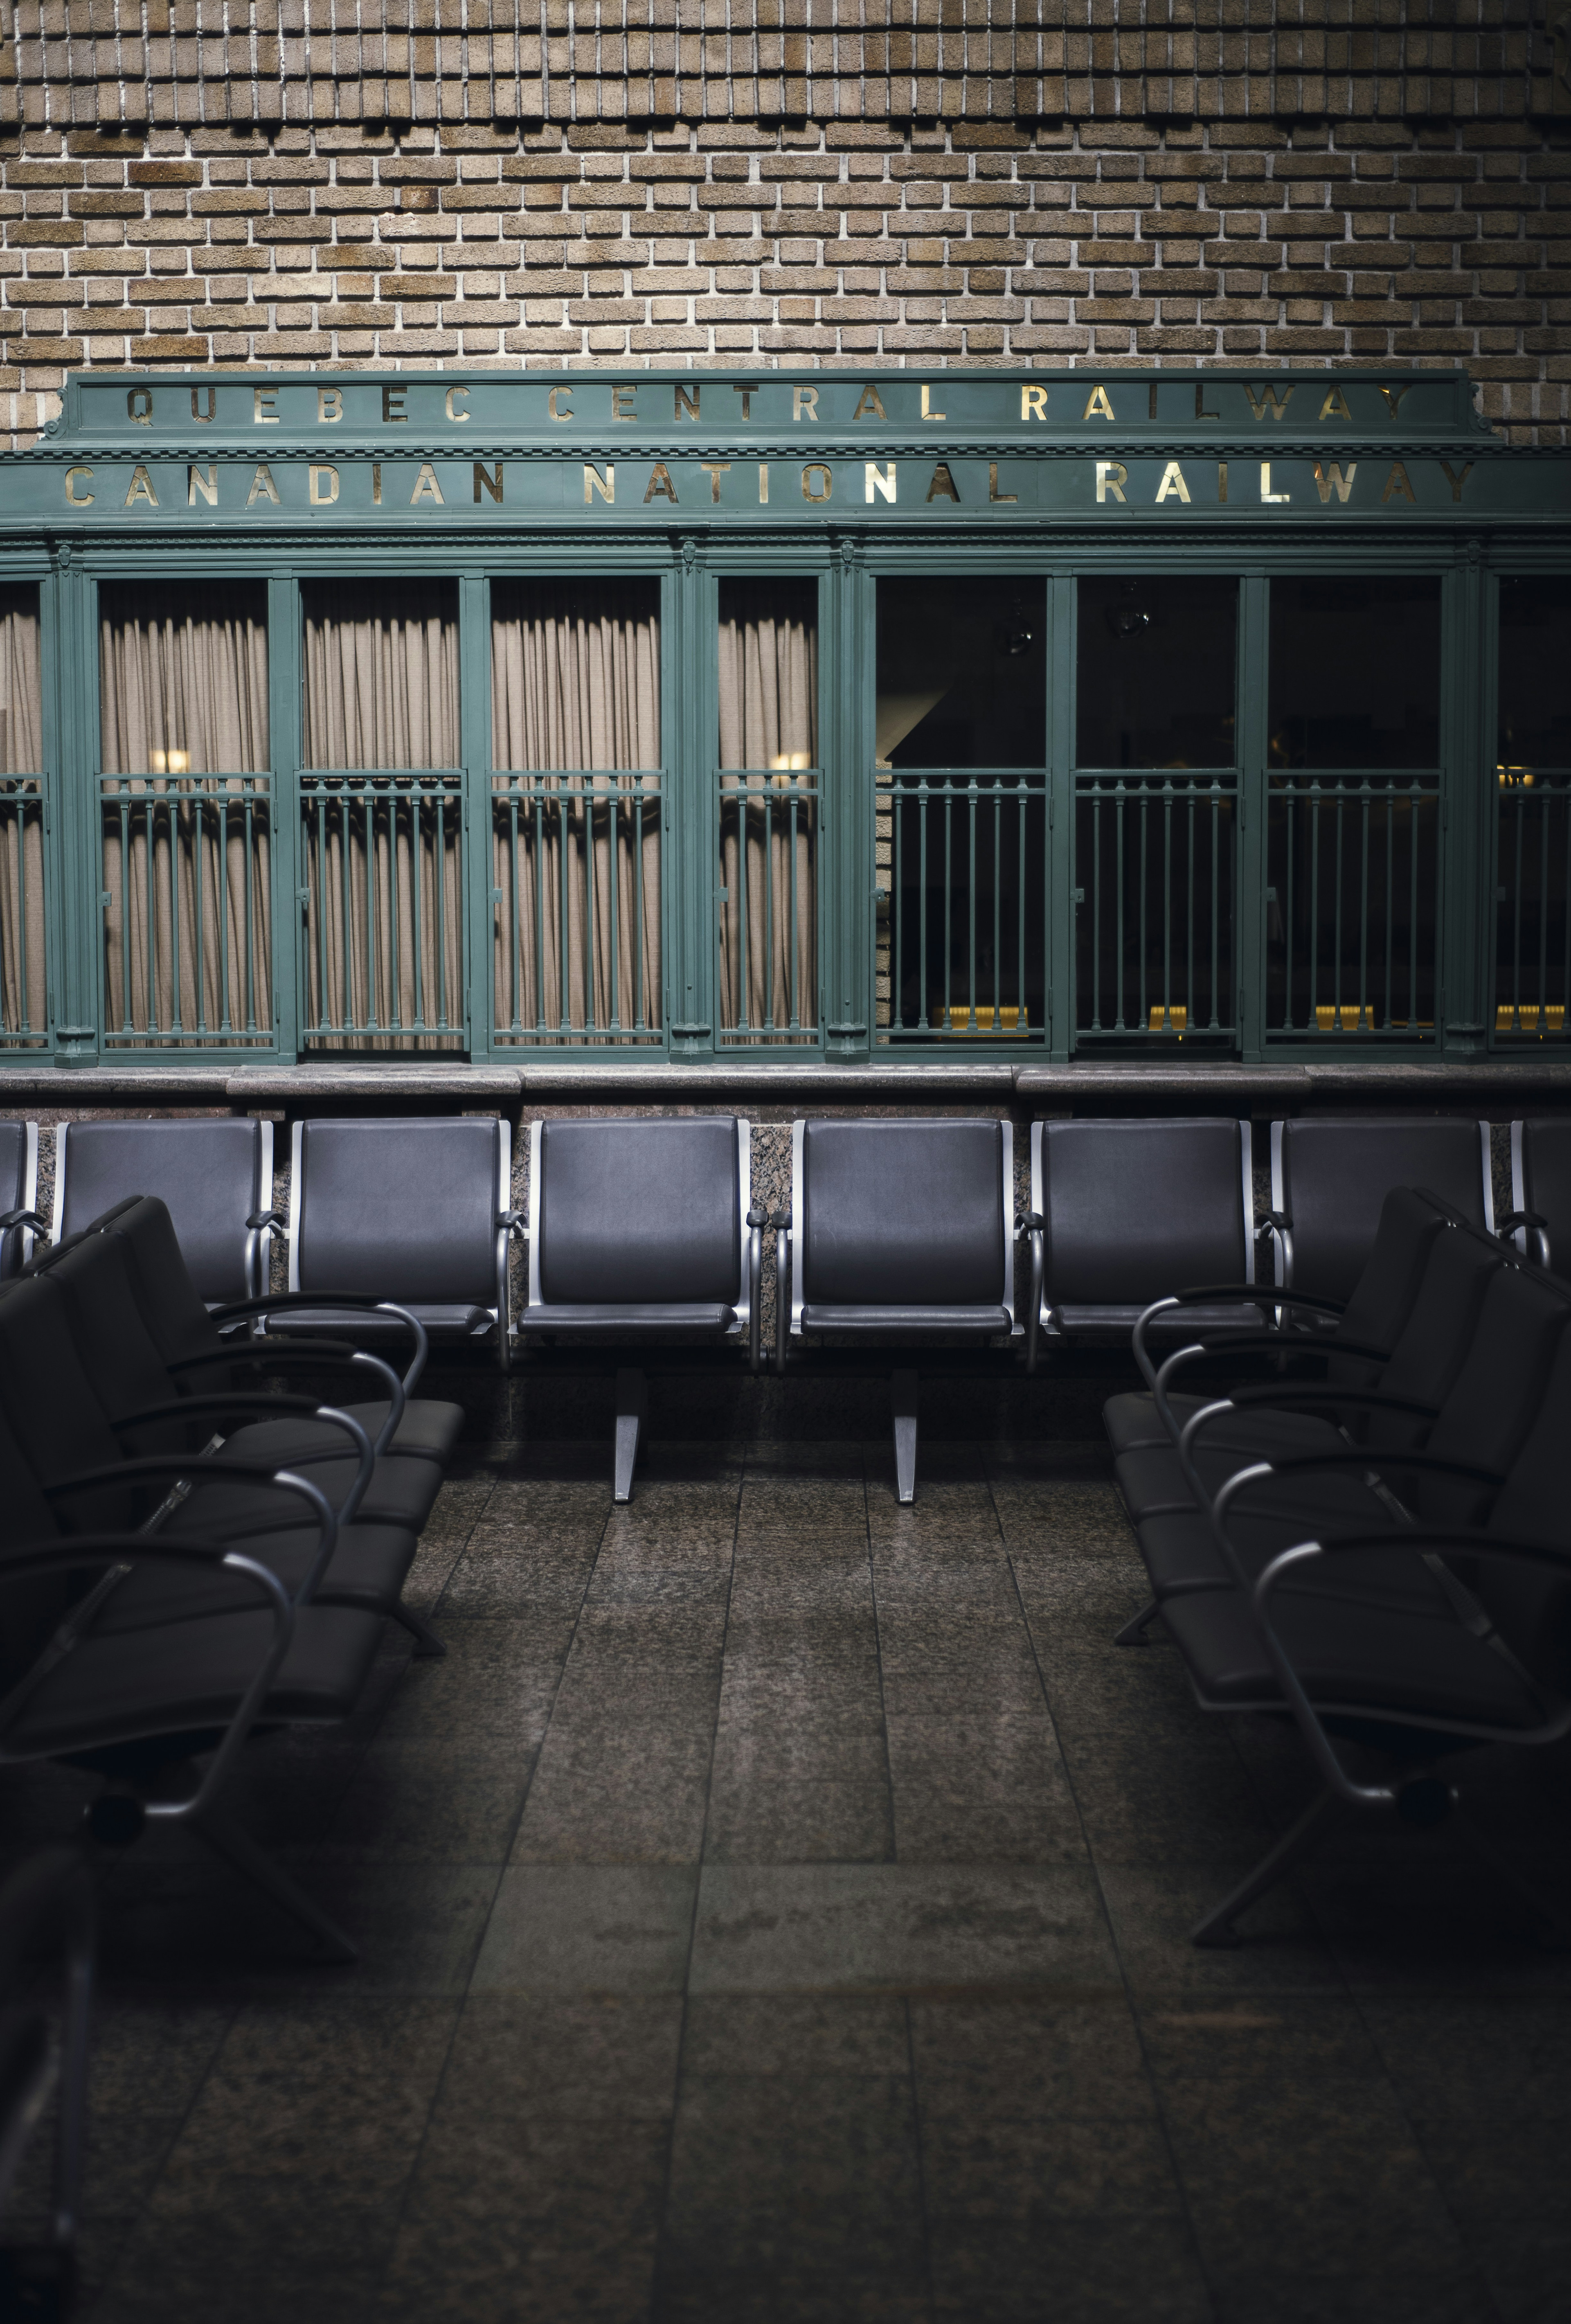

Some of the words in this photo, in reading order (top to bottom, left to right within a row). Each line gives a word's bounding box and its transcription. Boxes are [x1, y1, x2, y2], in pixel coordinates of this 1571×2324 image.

[127, 387, 471, 427] QUEBEC
[548, 385, 946, 421] CENTRAL
[1021, 384, 1411, 420] RAILWAY
[65, 463, 503, 507] CANADIAN
[584, 462, 1018, 504] NATIONAL
[1096, 461, 1474, 503] RAILWAY
